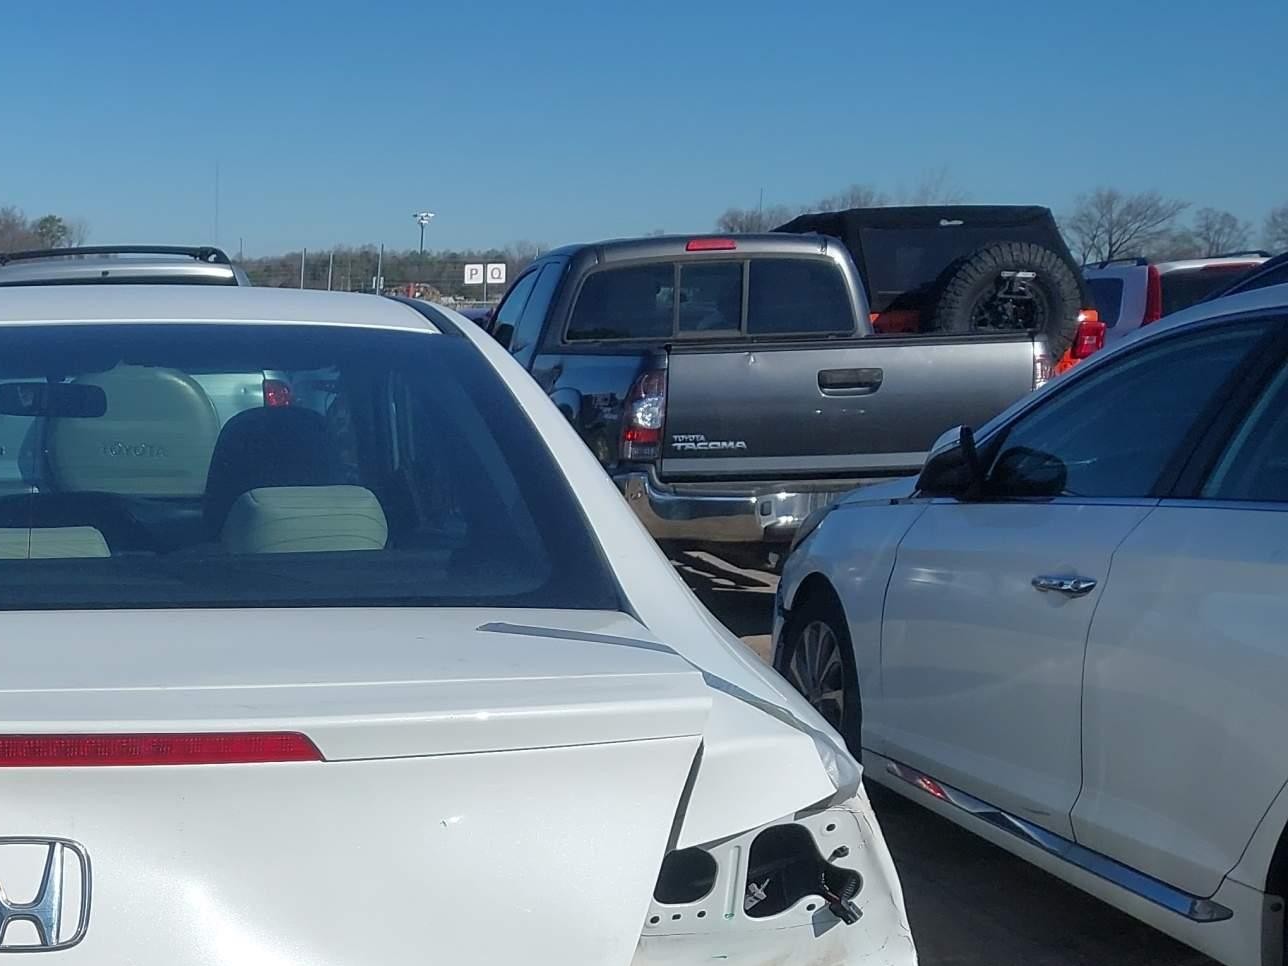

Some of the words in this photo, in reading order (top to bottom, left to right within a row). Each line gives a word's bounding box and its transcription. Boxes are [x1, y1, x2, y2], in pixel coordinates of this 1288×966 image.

[469, 267, 479, 280] P
[490, 266, 503, 280] Q
[672, 434, 706, 442] TOYOTA
[672, 441, 747, 451] TACOMA
